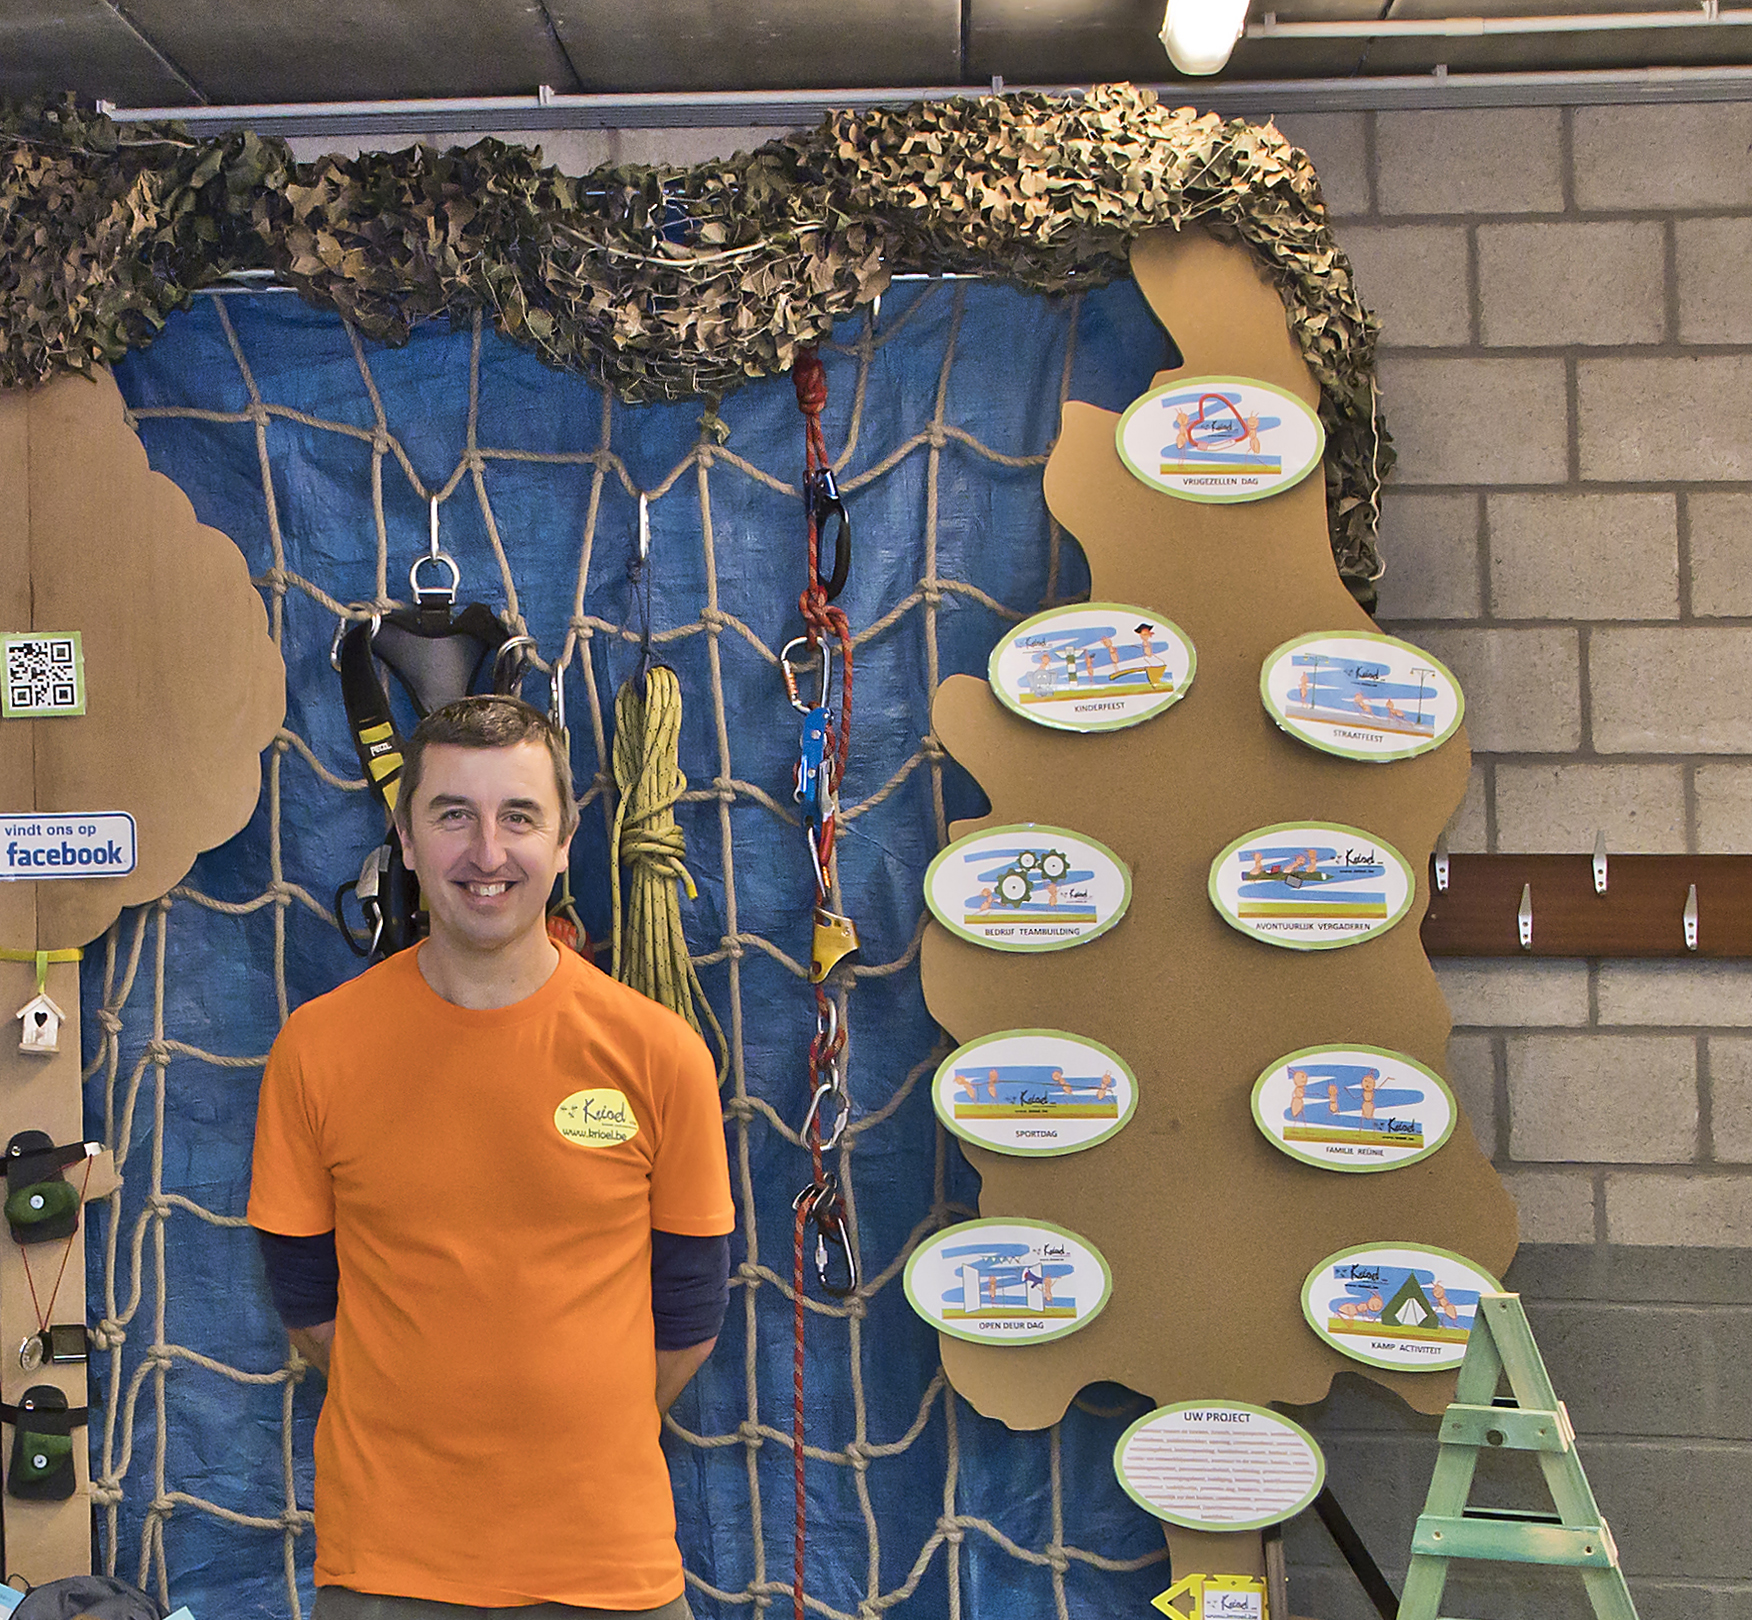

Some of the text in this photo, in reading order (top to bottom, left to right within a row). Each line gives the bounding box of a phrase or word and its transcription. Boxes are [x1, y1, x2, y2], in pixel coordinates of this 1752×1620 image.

[1074, 702, 1125, 712] KINDERFEEST
[1333, 729, 1384, 743] STRAATFEEST
[5, 824, 97, 838] vindt ons op
[7, 840, 123, 867] facebook
[1019, 927, 1080, 936] TEAMBUILDING
[1256, 923, 1371, 931] AVONTUURLIJK VERGADEREN
[1015, 1130, 1058, 1138] SPORTDAG
[1326, 1146, 1354, 1155] FAMILIE
[979, 1322, 1044, 1330] OPEN DEUR DAG
[1371, 1342, 1442, 1355] KAMP ACTIVITEIT
[1184, 1412, 1251, 1423] UW PROJECT
